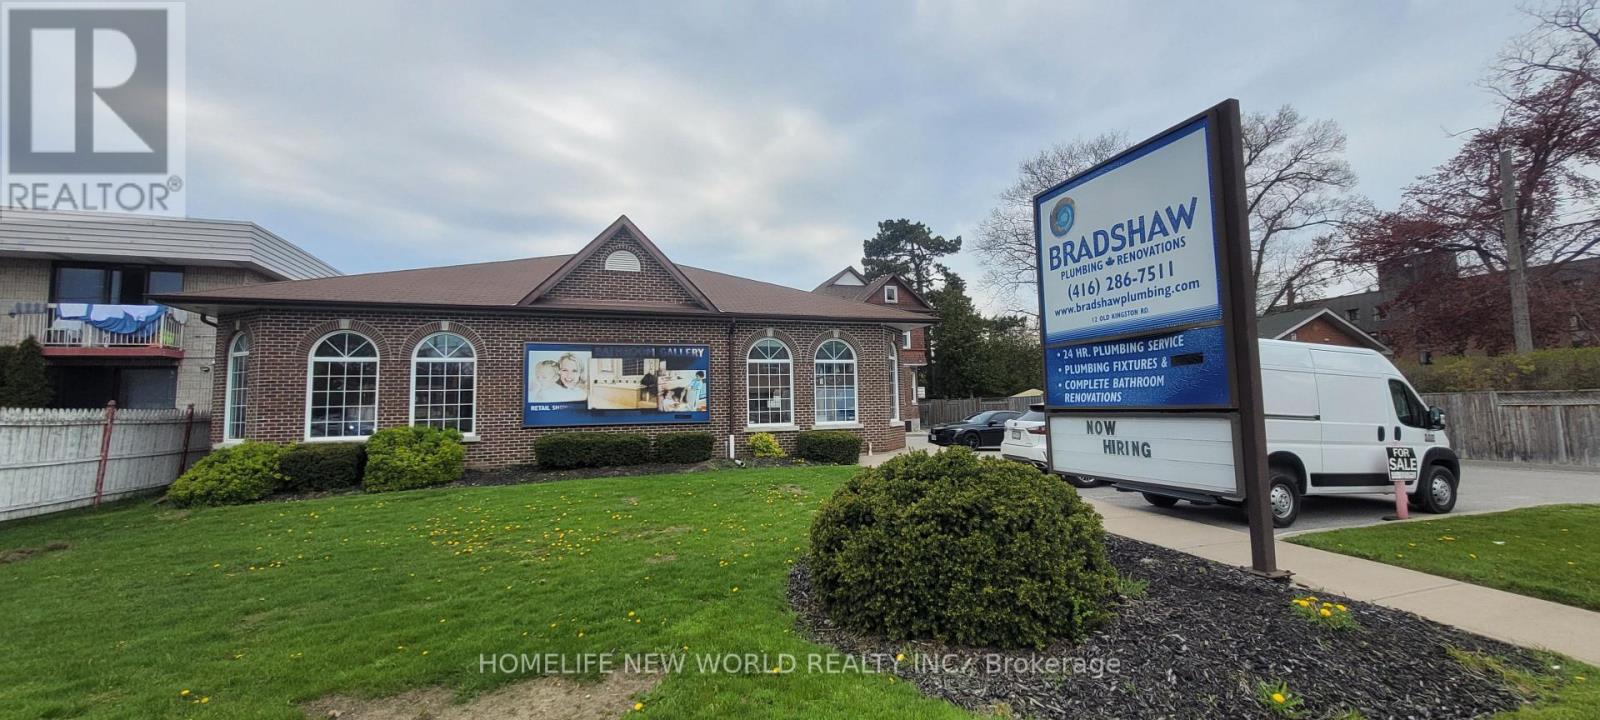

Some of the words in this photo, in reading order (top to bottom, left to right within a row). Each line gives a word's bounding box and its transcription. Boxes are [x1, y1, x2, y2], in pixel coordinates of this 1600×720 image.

[1050, 197, 1198, 271] BRADSHAW
[1061, 260, 1104, 280] PLUMBING
[1117, 236, 1187, 265] RENOVATIONS
[1068, 278, 1101, 302] (416)
[1106, 261, 1174, 292] 286-7511
[1055, 279, 1200, 317] www.bradshawplumbing.com
[1099, 313, 1110, 322] OLD
[1111, 309, 1139, 319] KINGSTON
[1063, 350, 1073, 360] 24
[1076, 348, 1092, 358] HR.
[1093, 341, 1145, 356] PLUMBING
[1147, 334, 1185, 351] SERVICE
[1065, 361, 1110, 375] PLUMBING
[1113, 357, 1158, 372] FIXTURES
[1161, 356, 1168, 368] &
[1065, 378, 1110, 390] COMPLETE
[1113, 375, 1165, 389] BATHROOM
[1065, 391, 1122, 403] RENOVATIONS
[1086, 420, 1116, 436] NOW
[1103, 439, 1152, 458] HIRING
[1393, 448, 1410, 457] FOR
[1390, 458, 1416, 470] SALE
